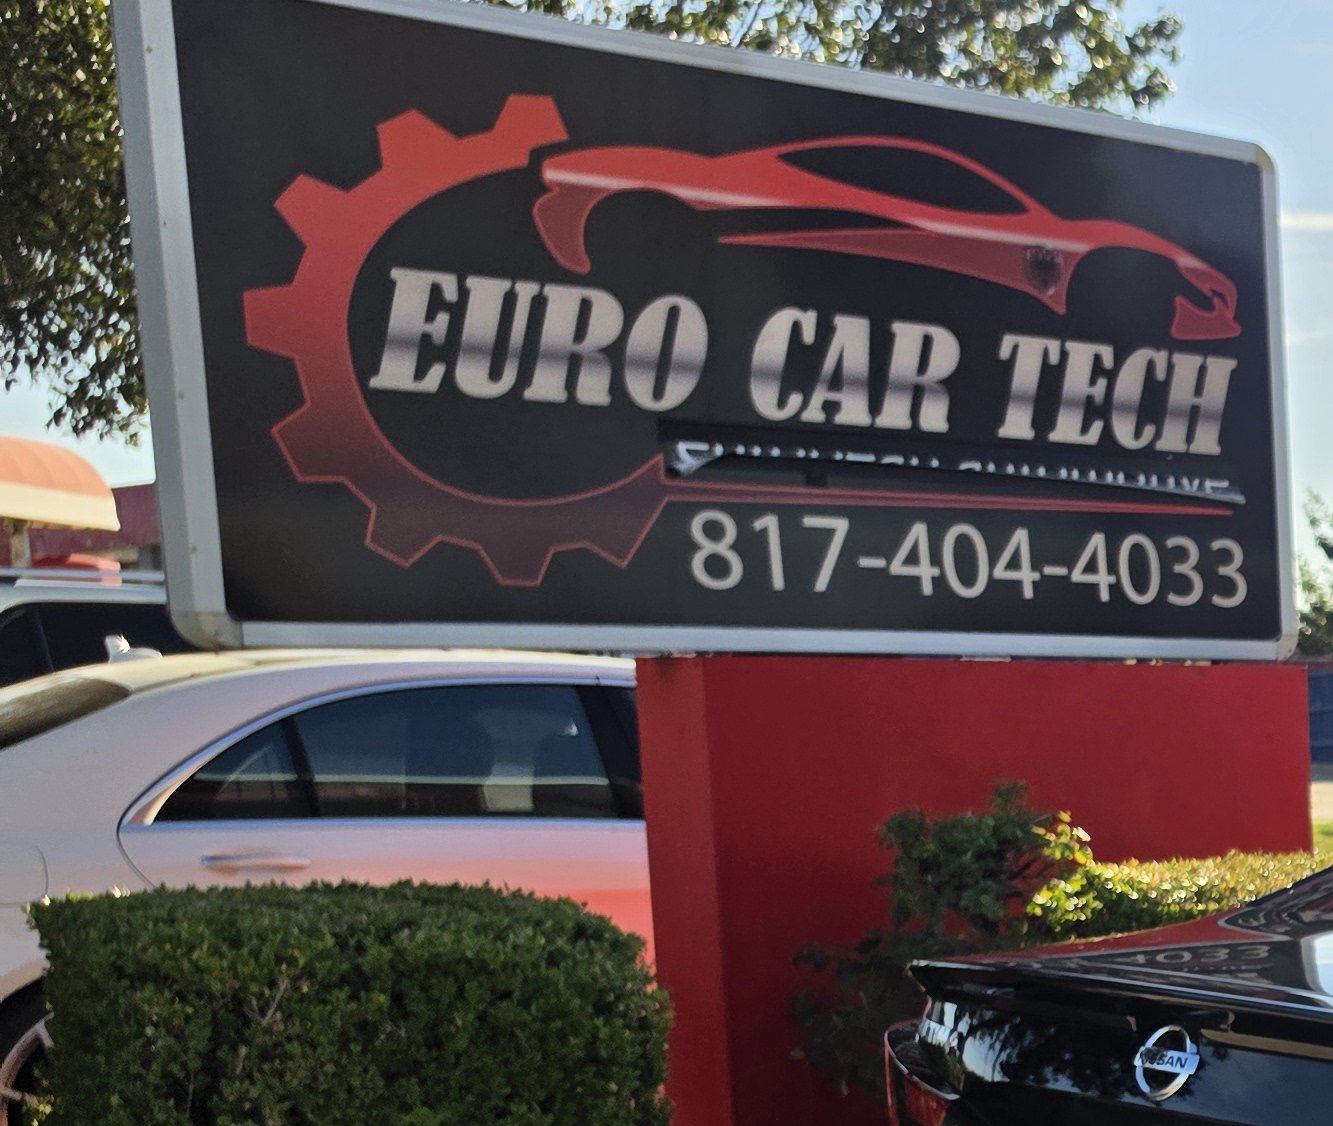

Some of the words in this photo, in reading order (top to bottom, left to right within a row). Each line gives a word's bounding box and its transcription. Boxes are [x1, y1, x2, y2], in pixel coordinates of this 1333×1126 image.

[368, 267, 709, 412] EURO
[749, 307, 962, 436] CAR
[997, 332, 1239, 457] TECH
[688, 508, 1249, 609] 817-404-4033
